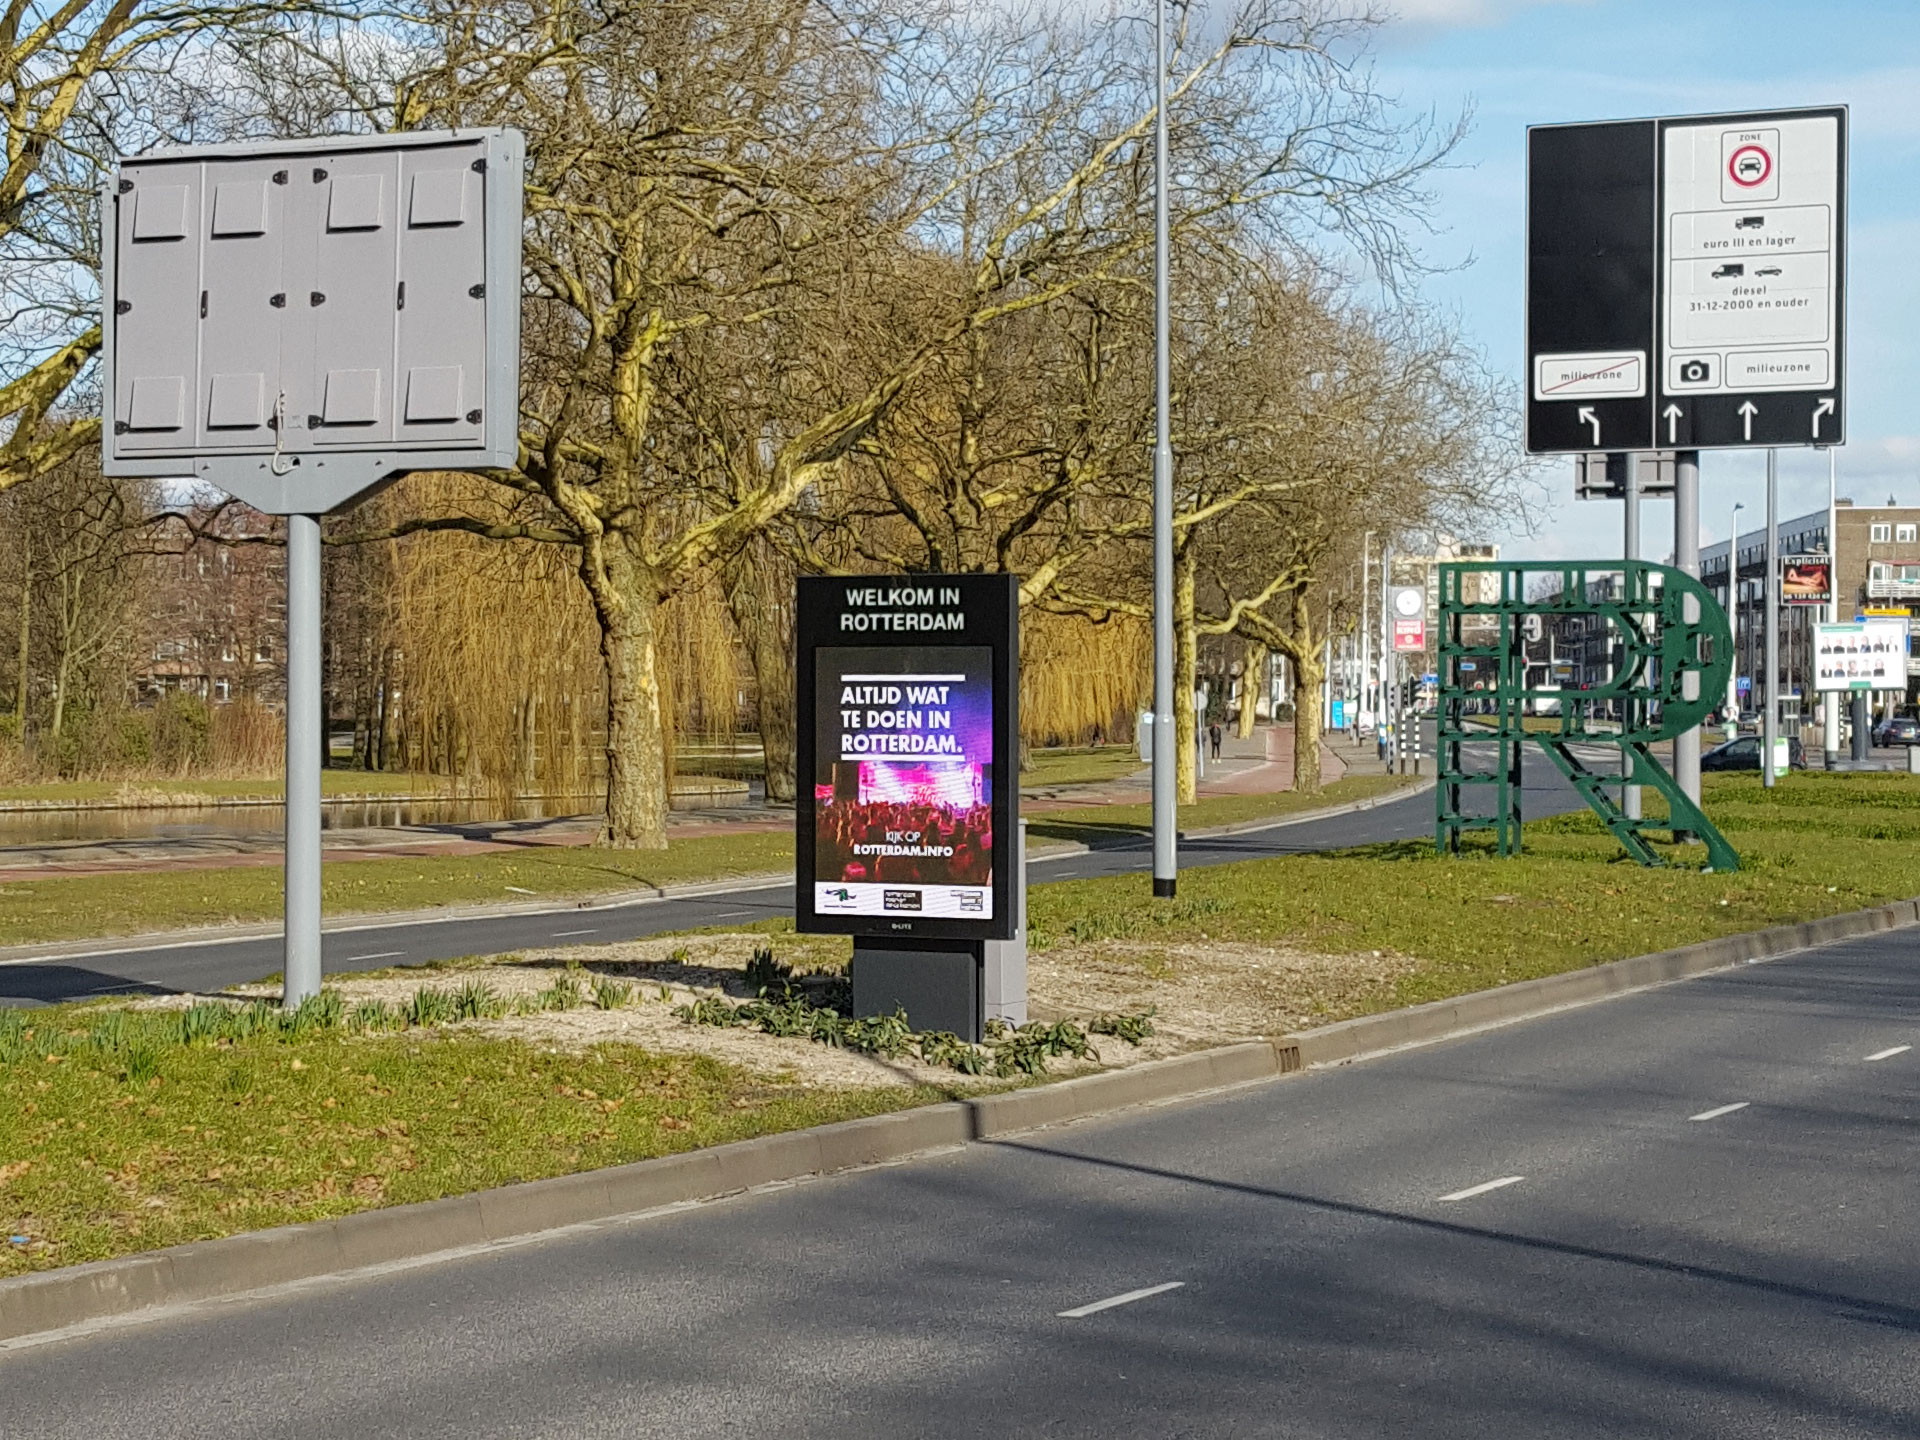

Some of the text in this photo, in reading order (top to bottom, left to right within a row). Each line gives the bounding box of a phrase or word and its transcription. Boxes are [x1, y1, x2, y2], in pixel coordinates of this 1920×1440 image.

[1739, 133, 1762, 142] ZONE
[1703, 240, 1729, 249] euro
[1748, 238, 1762, 246] en
[1766, 236, 1796, 247] lager
[1732, 284, 1767, 296] diesel
[1689, 298, 1809, 312] 31-12-2000 en ouder
[1746, 361, 1812, 375] milieuzone
[1560, 369, 1623, 382] milieuzone
[845, 587, 960, 606] WELKOM IN
[840, 612, 965, 631] ROTTERDAM
[840, 686, 950, 704] ALTIJD WAT
[840, 710, 951, 728] TE DOEN IN
[841, 734, 963, 753] ROTTERDAM.
[885, 831, 921, 843] KIJK OP
[853, 844, 954, 857] ROTTERDAM.INFO
